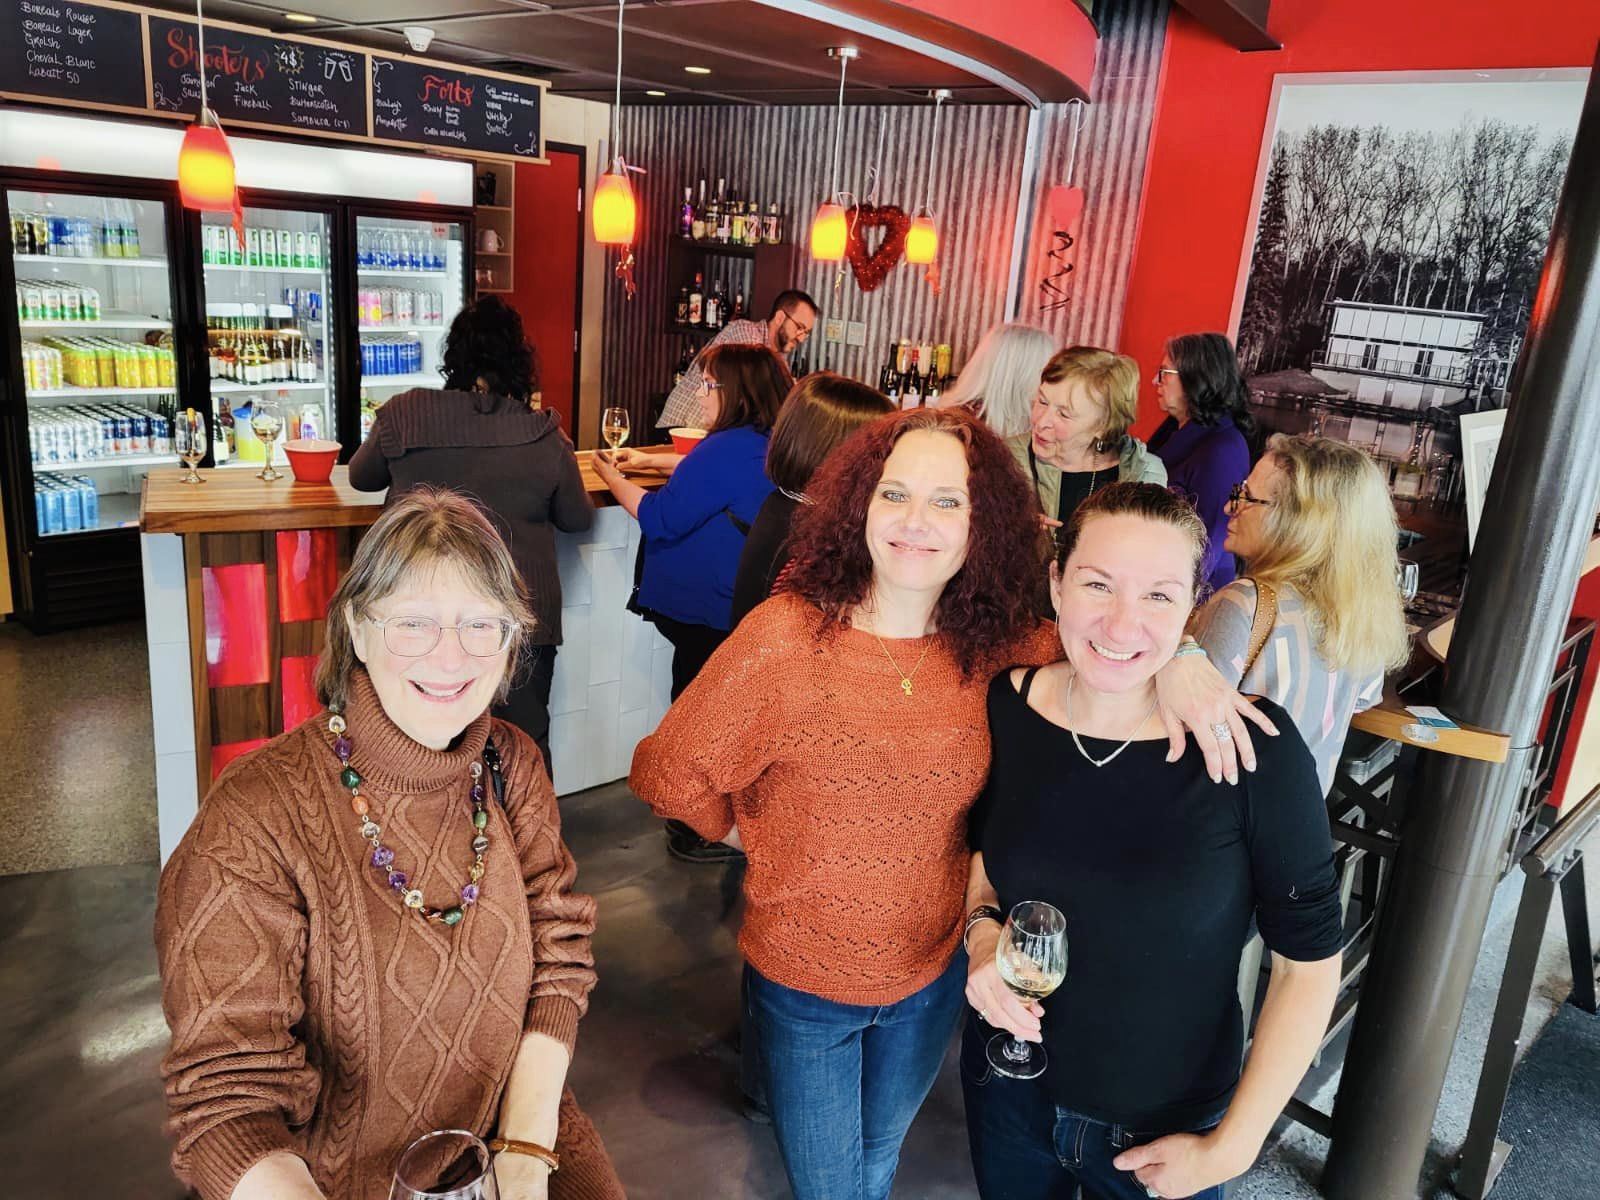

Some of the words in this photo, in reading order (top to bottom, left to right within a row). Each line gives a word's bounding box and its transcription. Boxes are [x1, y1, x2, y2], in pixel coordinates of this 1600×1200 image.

[65, 55, 96, 70] Blanc
[66, 71, 80, 84] 50
[234, 81, 258, 96] Jack
[418, 75, 474, 108] Forts
